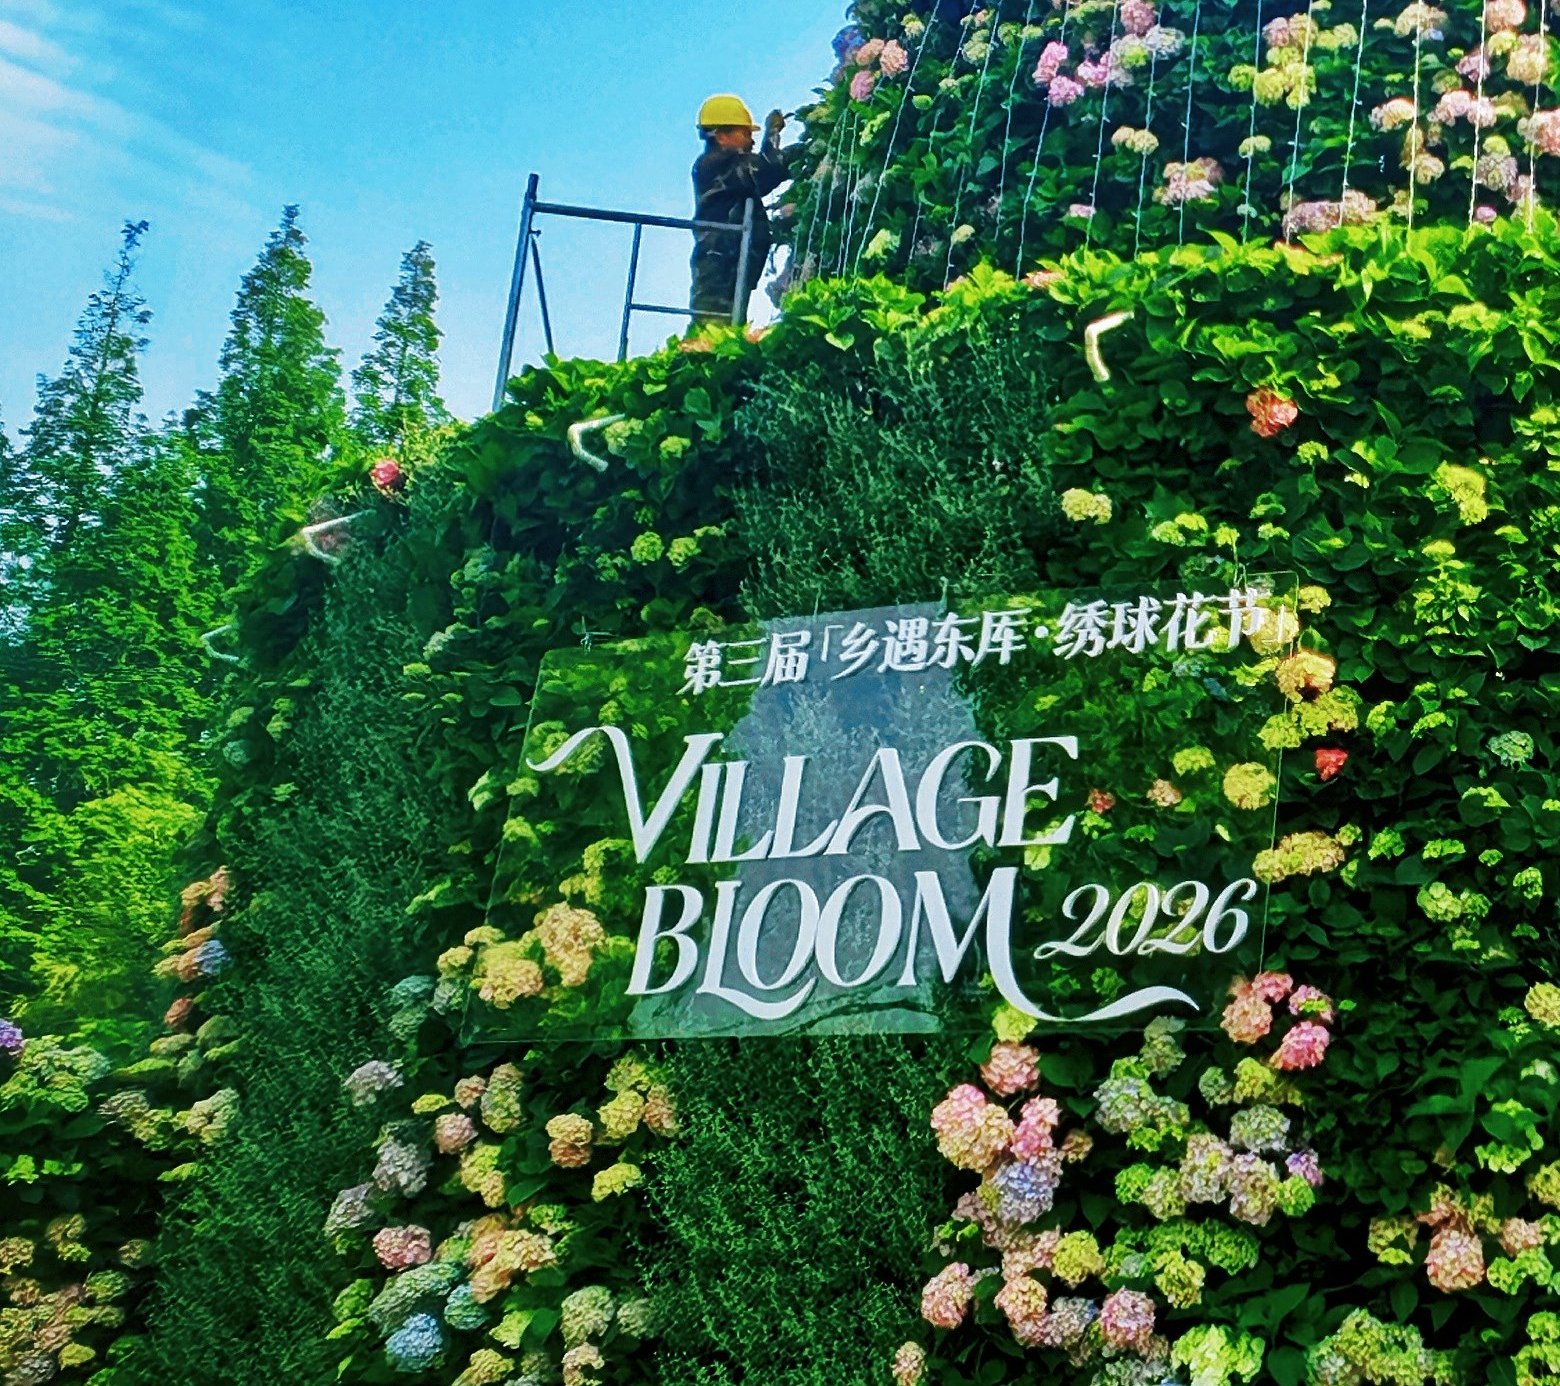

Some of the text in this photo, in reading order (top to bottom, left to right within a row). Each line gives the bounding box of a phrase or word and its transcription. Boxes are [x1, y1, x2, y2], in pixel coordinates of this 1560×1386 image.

[527, 725, 1079, 864] VILLAGE
[627, 865, 1257, 1022] BLOOM 2026
